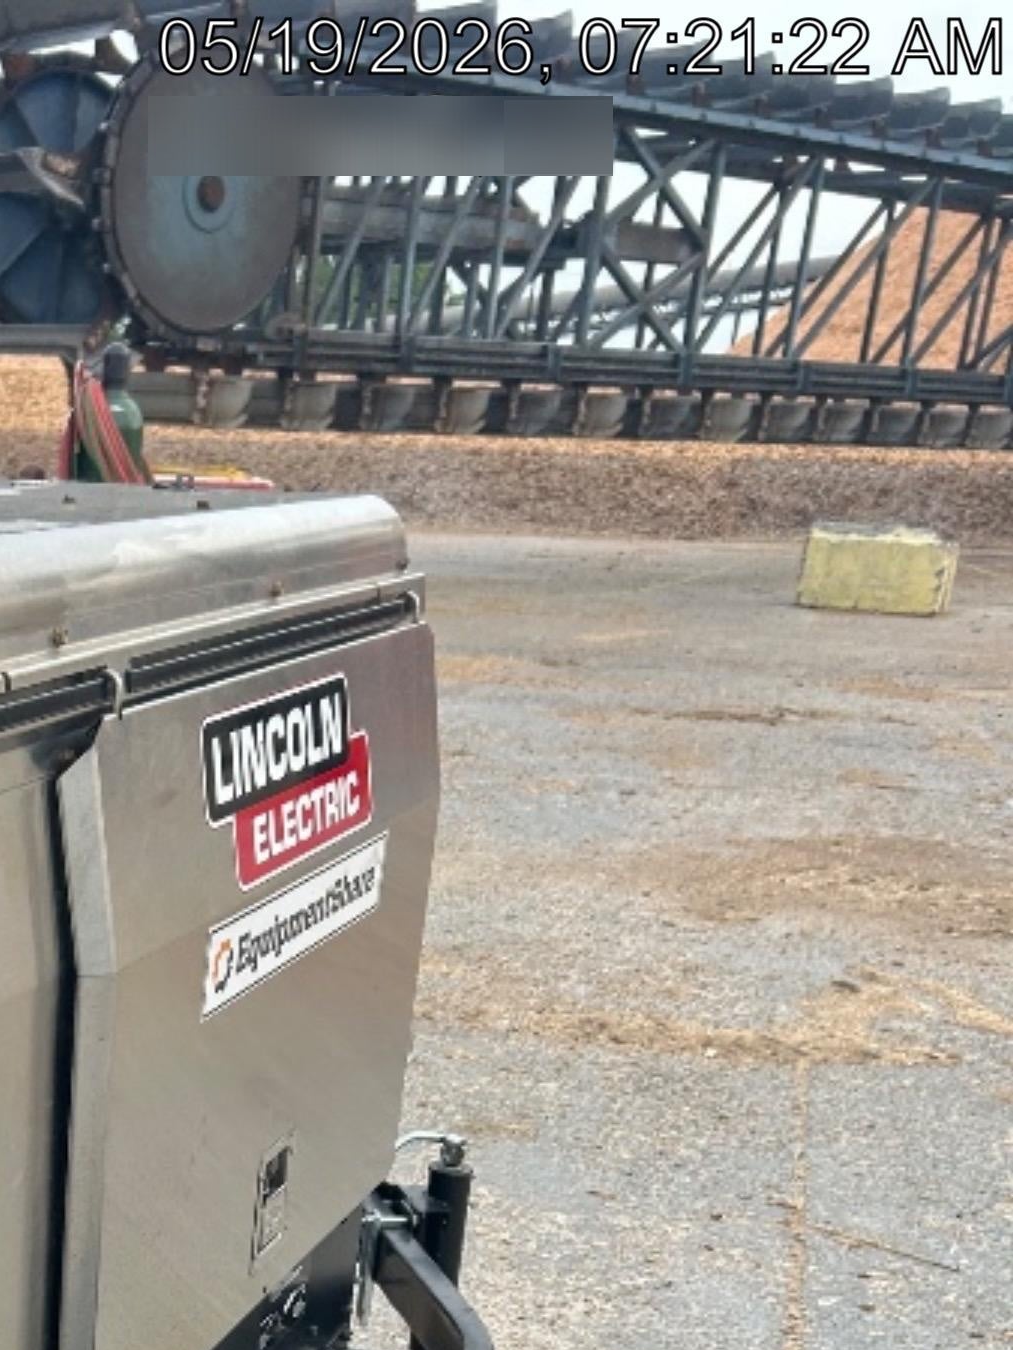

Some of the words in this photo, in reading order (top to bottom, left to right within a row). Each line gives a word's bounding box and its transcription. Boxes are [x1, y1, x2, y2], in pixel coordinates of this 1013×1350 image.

[211, 692, 344, 804] LINCOLN
[252, 771, 360, 865] ELECTRIC
[235, 866, 376, 973] EquipmentShare
